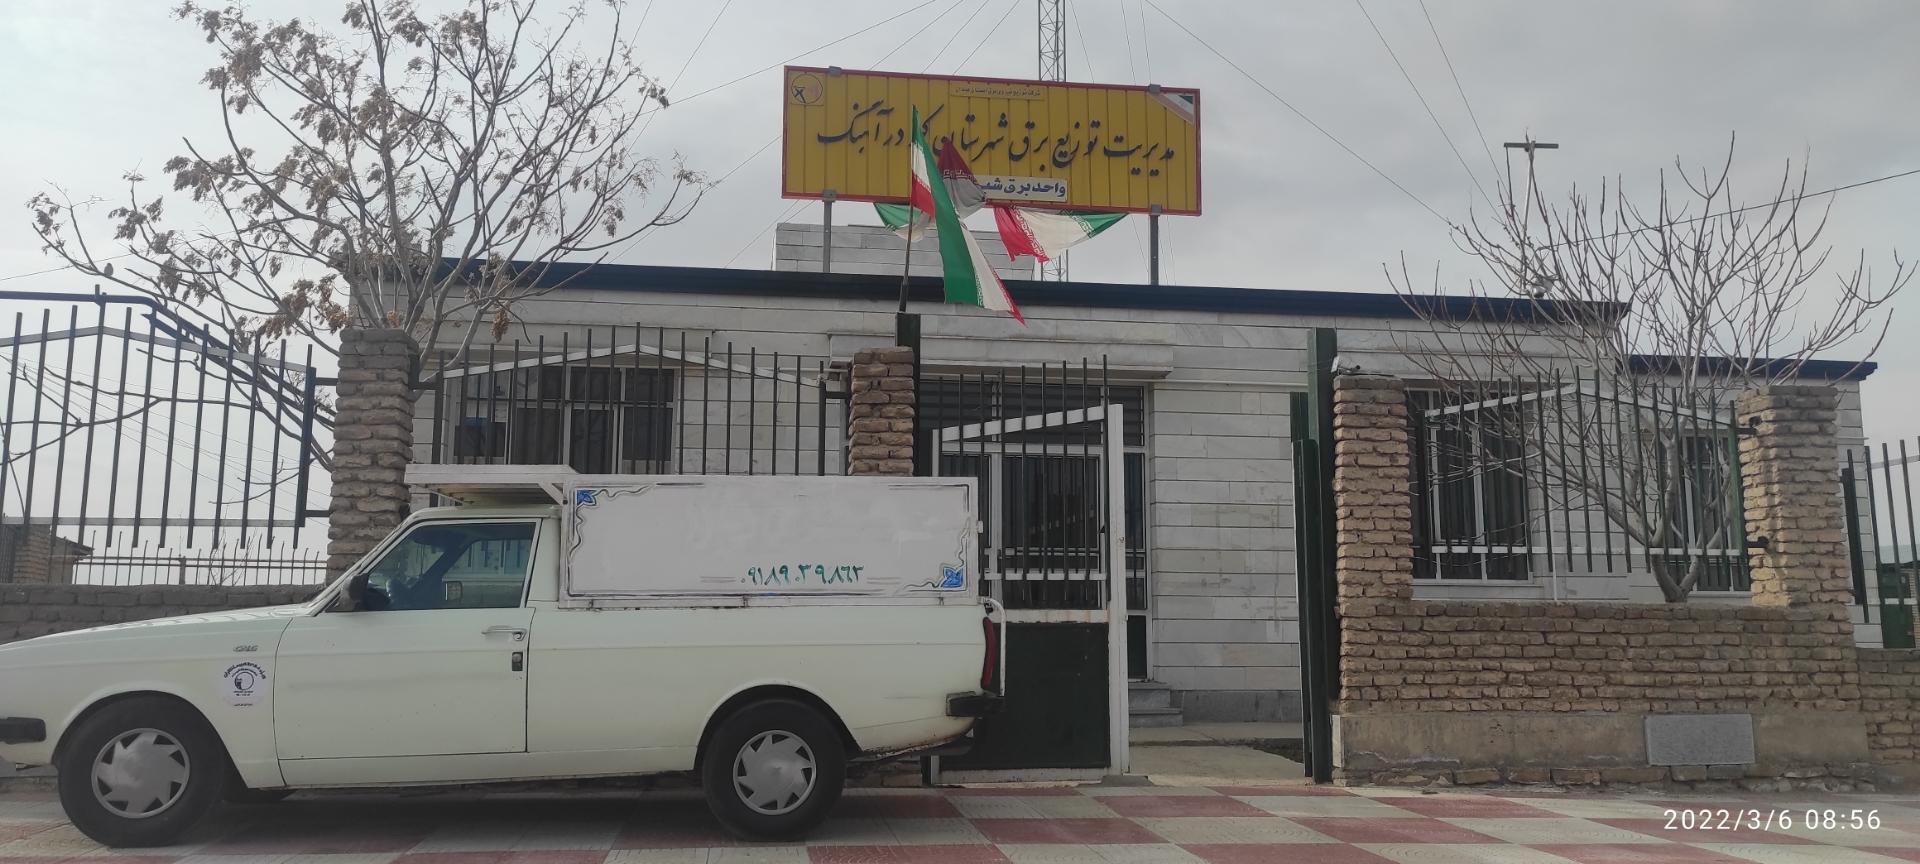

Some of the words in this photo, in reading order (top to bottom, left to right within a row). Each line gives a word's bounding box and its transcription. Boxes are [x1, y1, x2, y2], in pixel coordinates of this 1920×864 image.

[1008, 120, 1048, 172] برق
[1052, 120, 1100, 168] توزیع
[1104, 135, 1174, 177] مدیریت
[1003, 178, 1031, 196] برق
[1032, 182, 1066, 198] واحد
